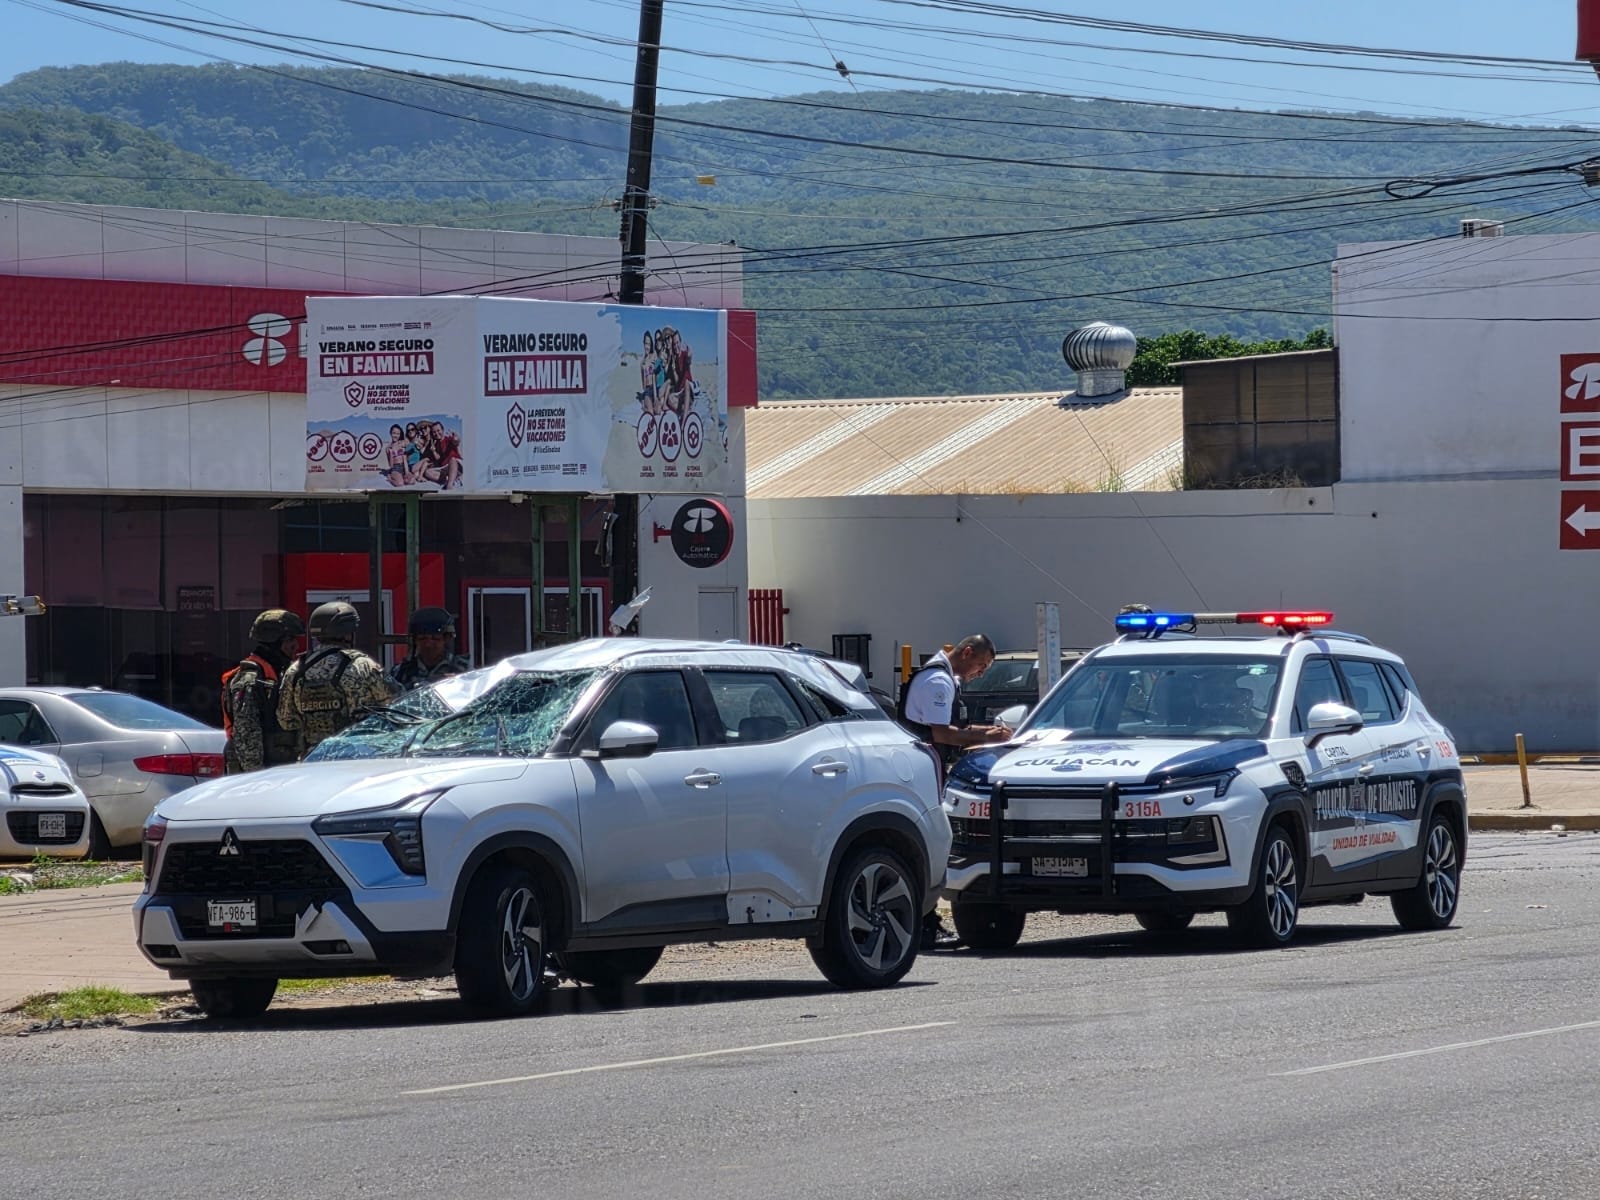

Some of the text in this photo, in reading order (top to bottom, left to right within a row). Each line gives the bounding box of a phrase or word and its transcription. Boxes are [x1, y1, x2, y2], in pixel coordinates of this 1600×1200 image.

[318, 339, 434, 353] VERANO SEGURO
[484, 333, 588, 353] VERANO SEGURO
[323, 354, 430, 374] EN FAMILIA
[487, 360, 584, 391] EN FAMILIA
[527, 418, 566, 430] NO SE TOMA
[527, 431, 566, 442] VACACIONES
[1569, 428, 1600, 475] E
[1367, 784, 1378, 814] DE
[969, 801, 991, 817] 315
[1125, 802, 1162, 818] 315A
[1333, 835, 1358, 850] UNIDAD
[1359, 834, 1368, 847] DE
